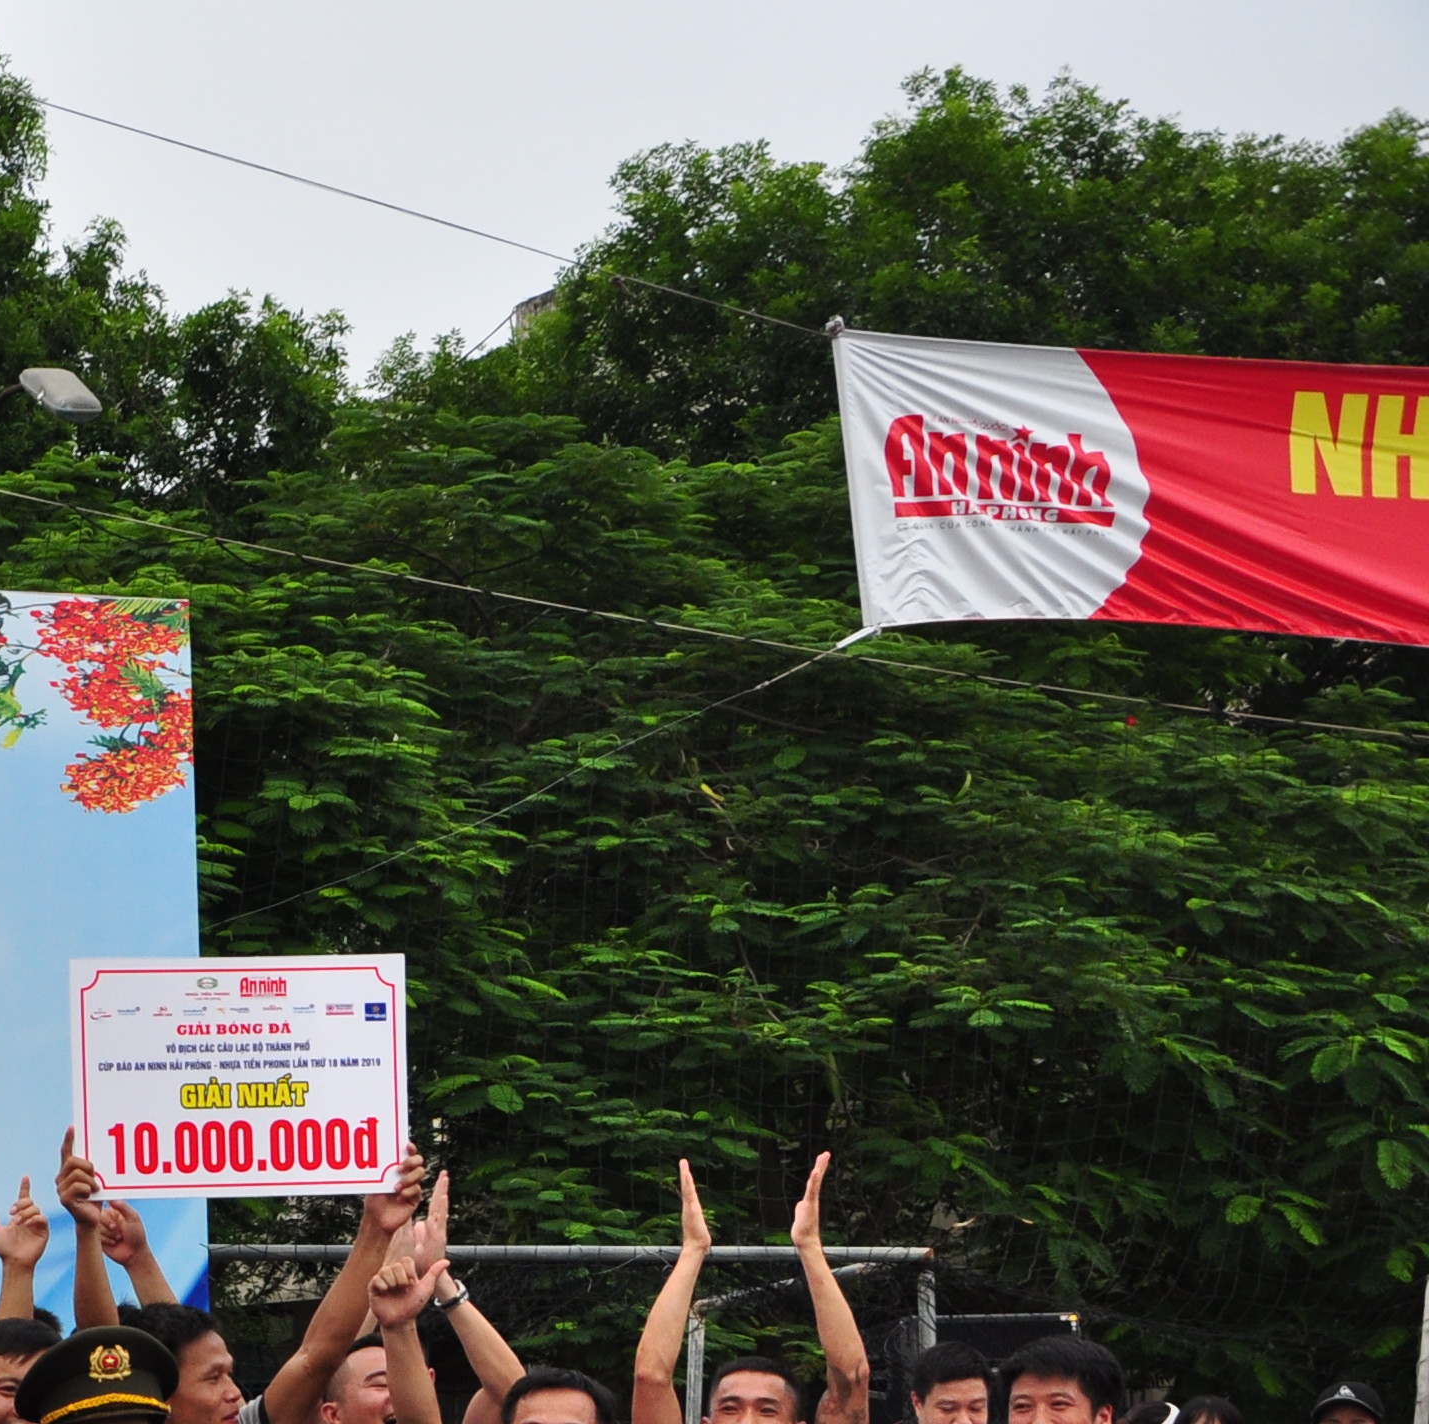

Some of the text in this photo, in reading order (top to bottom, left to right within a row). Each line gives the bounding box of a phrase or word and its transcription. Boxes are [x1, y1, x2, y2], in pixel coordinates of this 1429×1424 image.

[176, 1020, 292, 1036] GIẢI BÓNG ĐÁ
[180, 1073, 309, 1109] GIẢI NHẤT
[107, 1116, 380, 1176] 10.000.000đ
